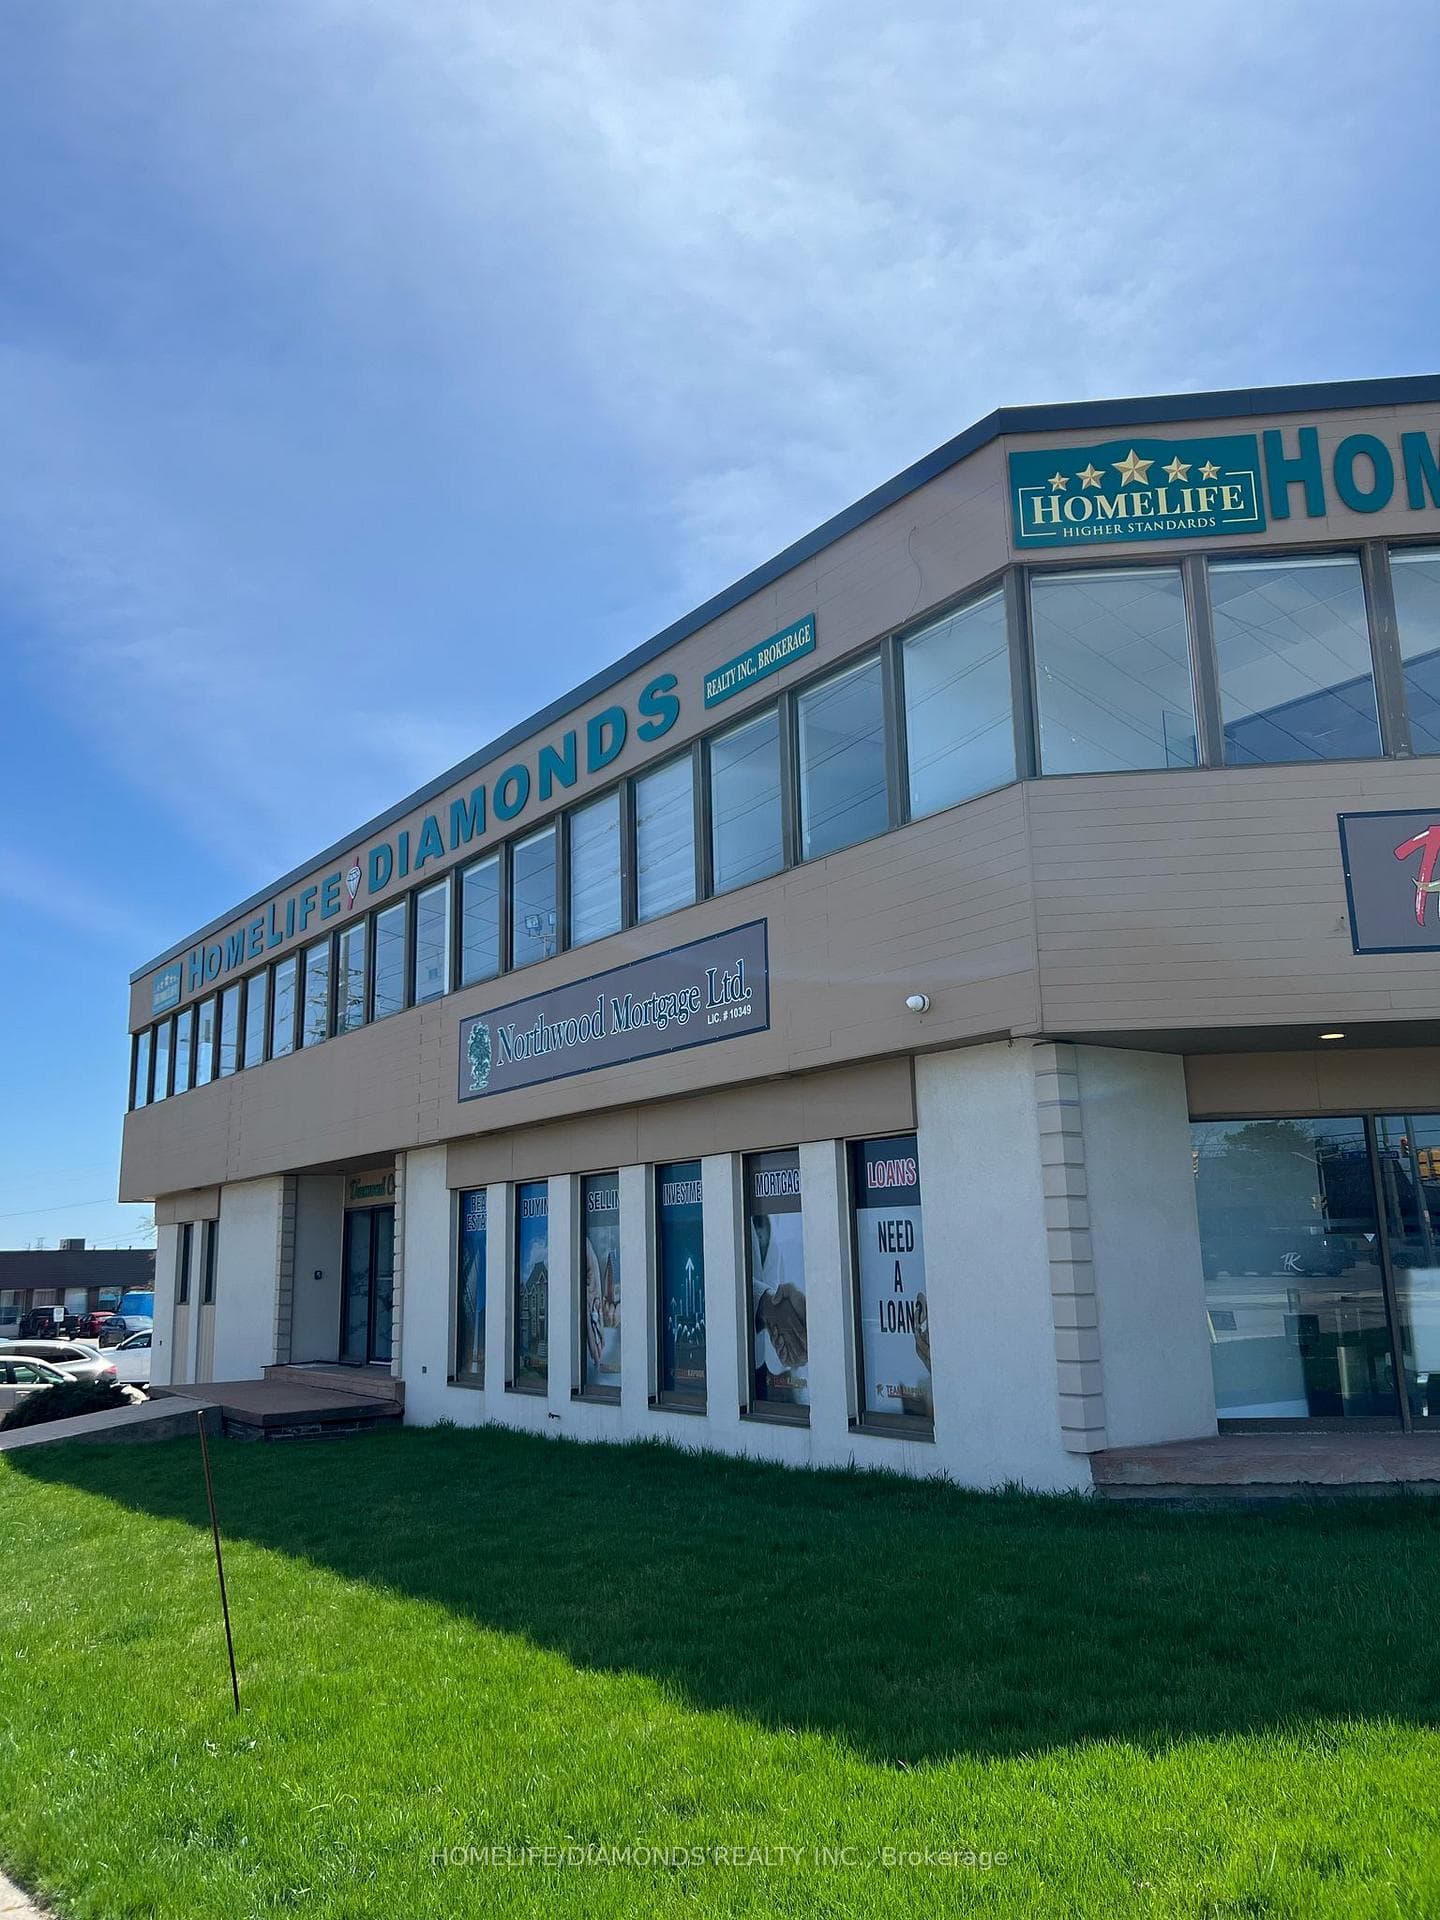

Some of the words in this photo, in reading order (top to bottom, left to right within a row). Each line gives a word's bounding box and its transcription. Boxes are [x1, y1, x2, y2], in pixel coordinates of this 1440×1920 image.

[1031, 484, 1244, 524] HOMELIFE
[1063, 522, 1123, 538] HIGHER
[1128, 516, 1217, 534] STANDARDS
[706, 666, 736, 699] REALTY
[758, 624, 811, 669] BROKERAGE
[187, 871, 342, 993] HOMELIFE
[368, 673, 680, 895] DIAMONDS
[497, 994, 605, 1066] Northwood
[611, 984, 701, 1034] Mortgage
[705, 958, 752, 1008] Ltd.
[707, 1012, 722, 1025] LIC.
[729, 1004, 752, 1019] 10349
[866, 1157, 917, 1189] LOANS
[878, 1219, 914, 1253] NEED
[894, 1260, 904, 1293] A
[879, 1299, 923, 1334] LOAN?
